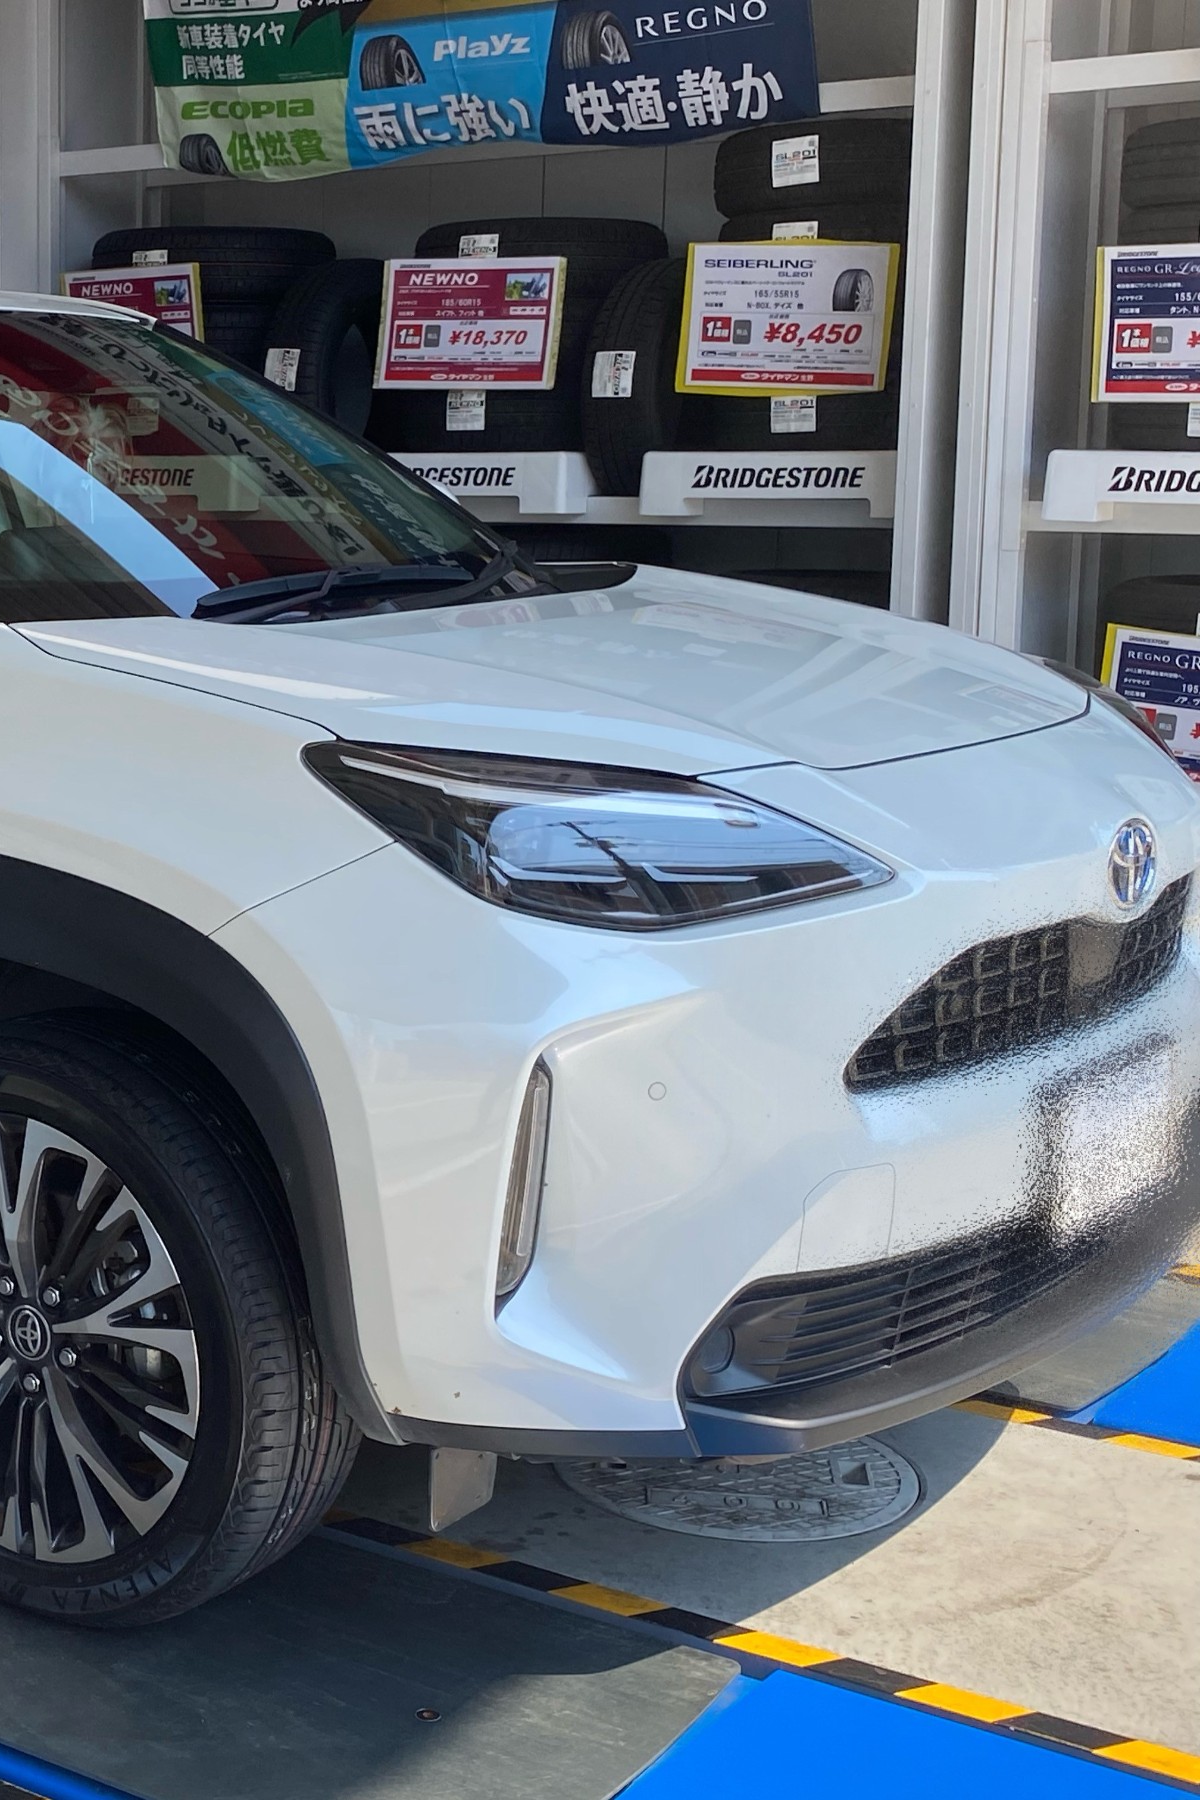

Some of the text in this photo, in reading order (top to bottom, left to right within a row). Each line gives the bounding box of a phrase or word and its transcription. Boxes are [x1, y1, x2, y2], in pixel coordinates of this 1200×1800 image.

[635, 0, 767, 38] REGNO
[176, 21, 286, 50] 新車装着タイヤ
[182, 54, 246, 80] 同等性能
[353, 92, 531, 150] 雨に強い
[226, 127, 332, 173] 低燃費
[704, 259, 814, 269] SEIBERLING
[81, 282, 134, 297] NEWNO
[409, 273, 479, 286] NEWNO
[448, 330, 528, 349] ¥18,370
[763, 322, 863, 347] ¥8,450
[119, 467, 195, 487] GESTONE
[691, 464, 866, 489] BRIDGESTONE
[1127, 650, 1171, 663] REGNO
